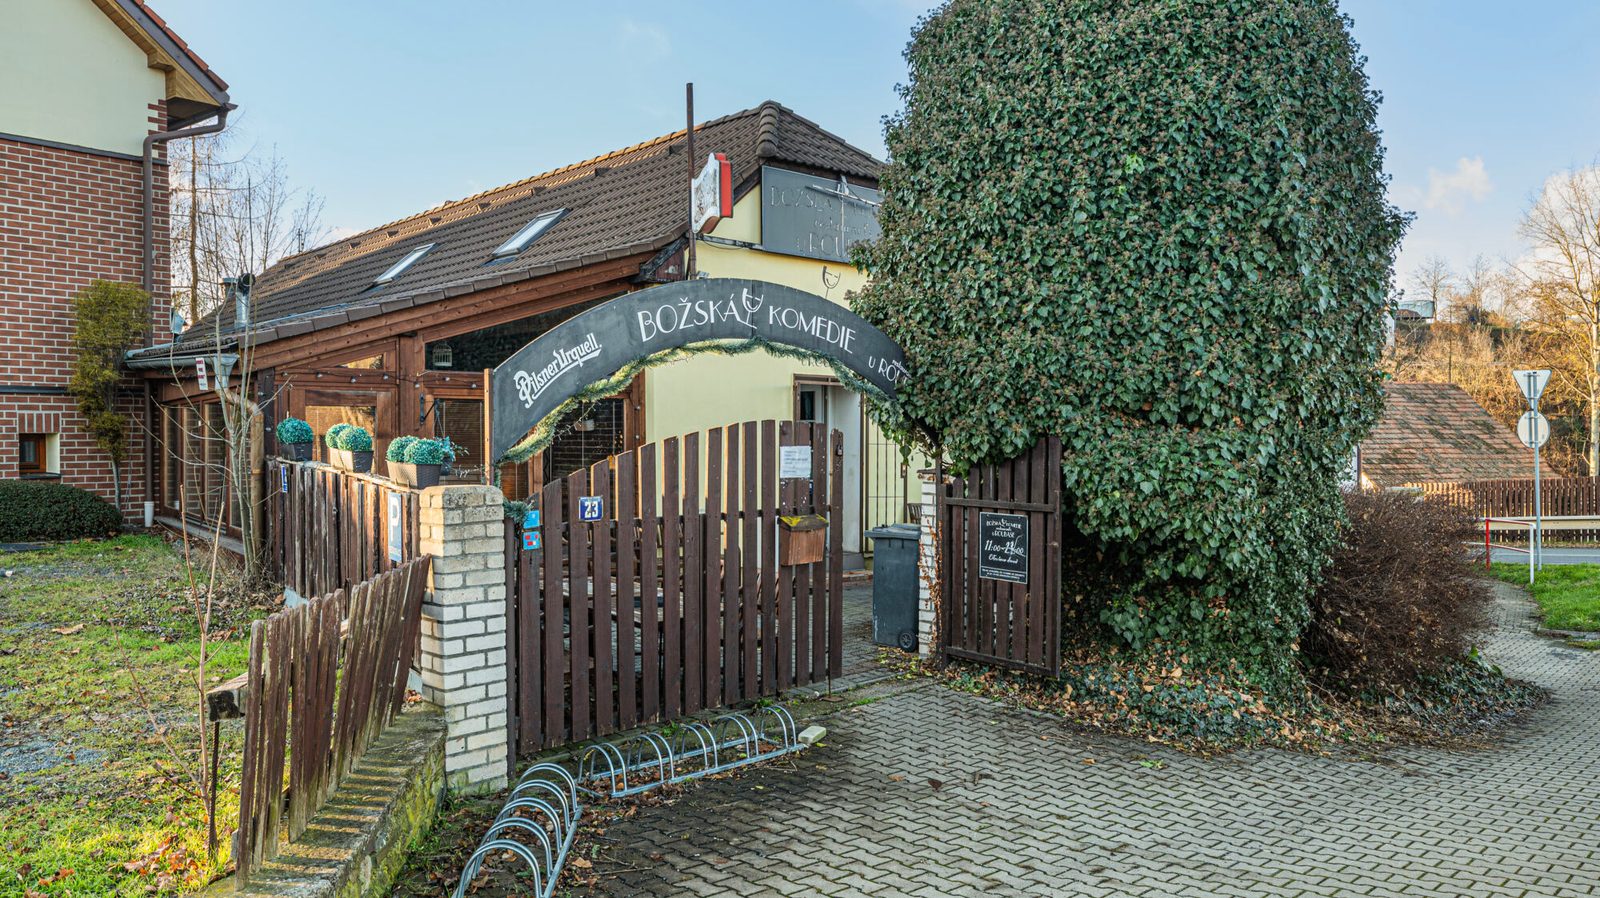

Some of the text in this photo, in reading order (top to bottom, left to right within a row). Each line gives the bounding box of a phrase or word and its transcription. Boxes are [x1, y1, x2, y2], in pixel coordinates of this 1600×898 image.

[637, 294, 752, 342] BOŽSKÁ
[513, 352, 560, 409] Pilsner
[389, 496, 400, 542] P
[584, 501, 599, 519] 23
